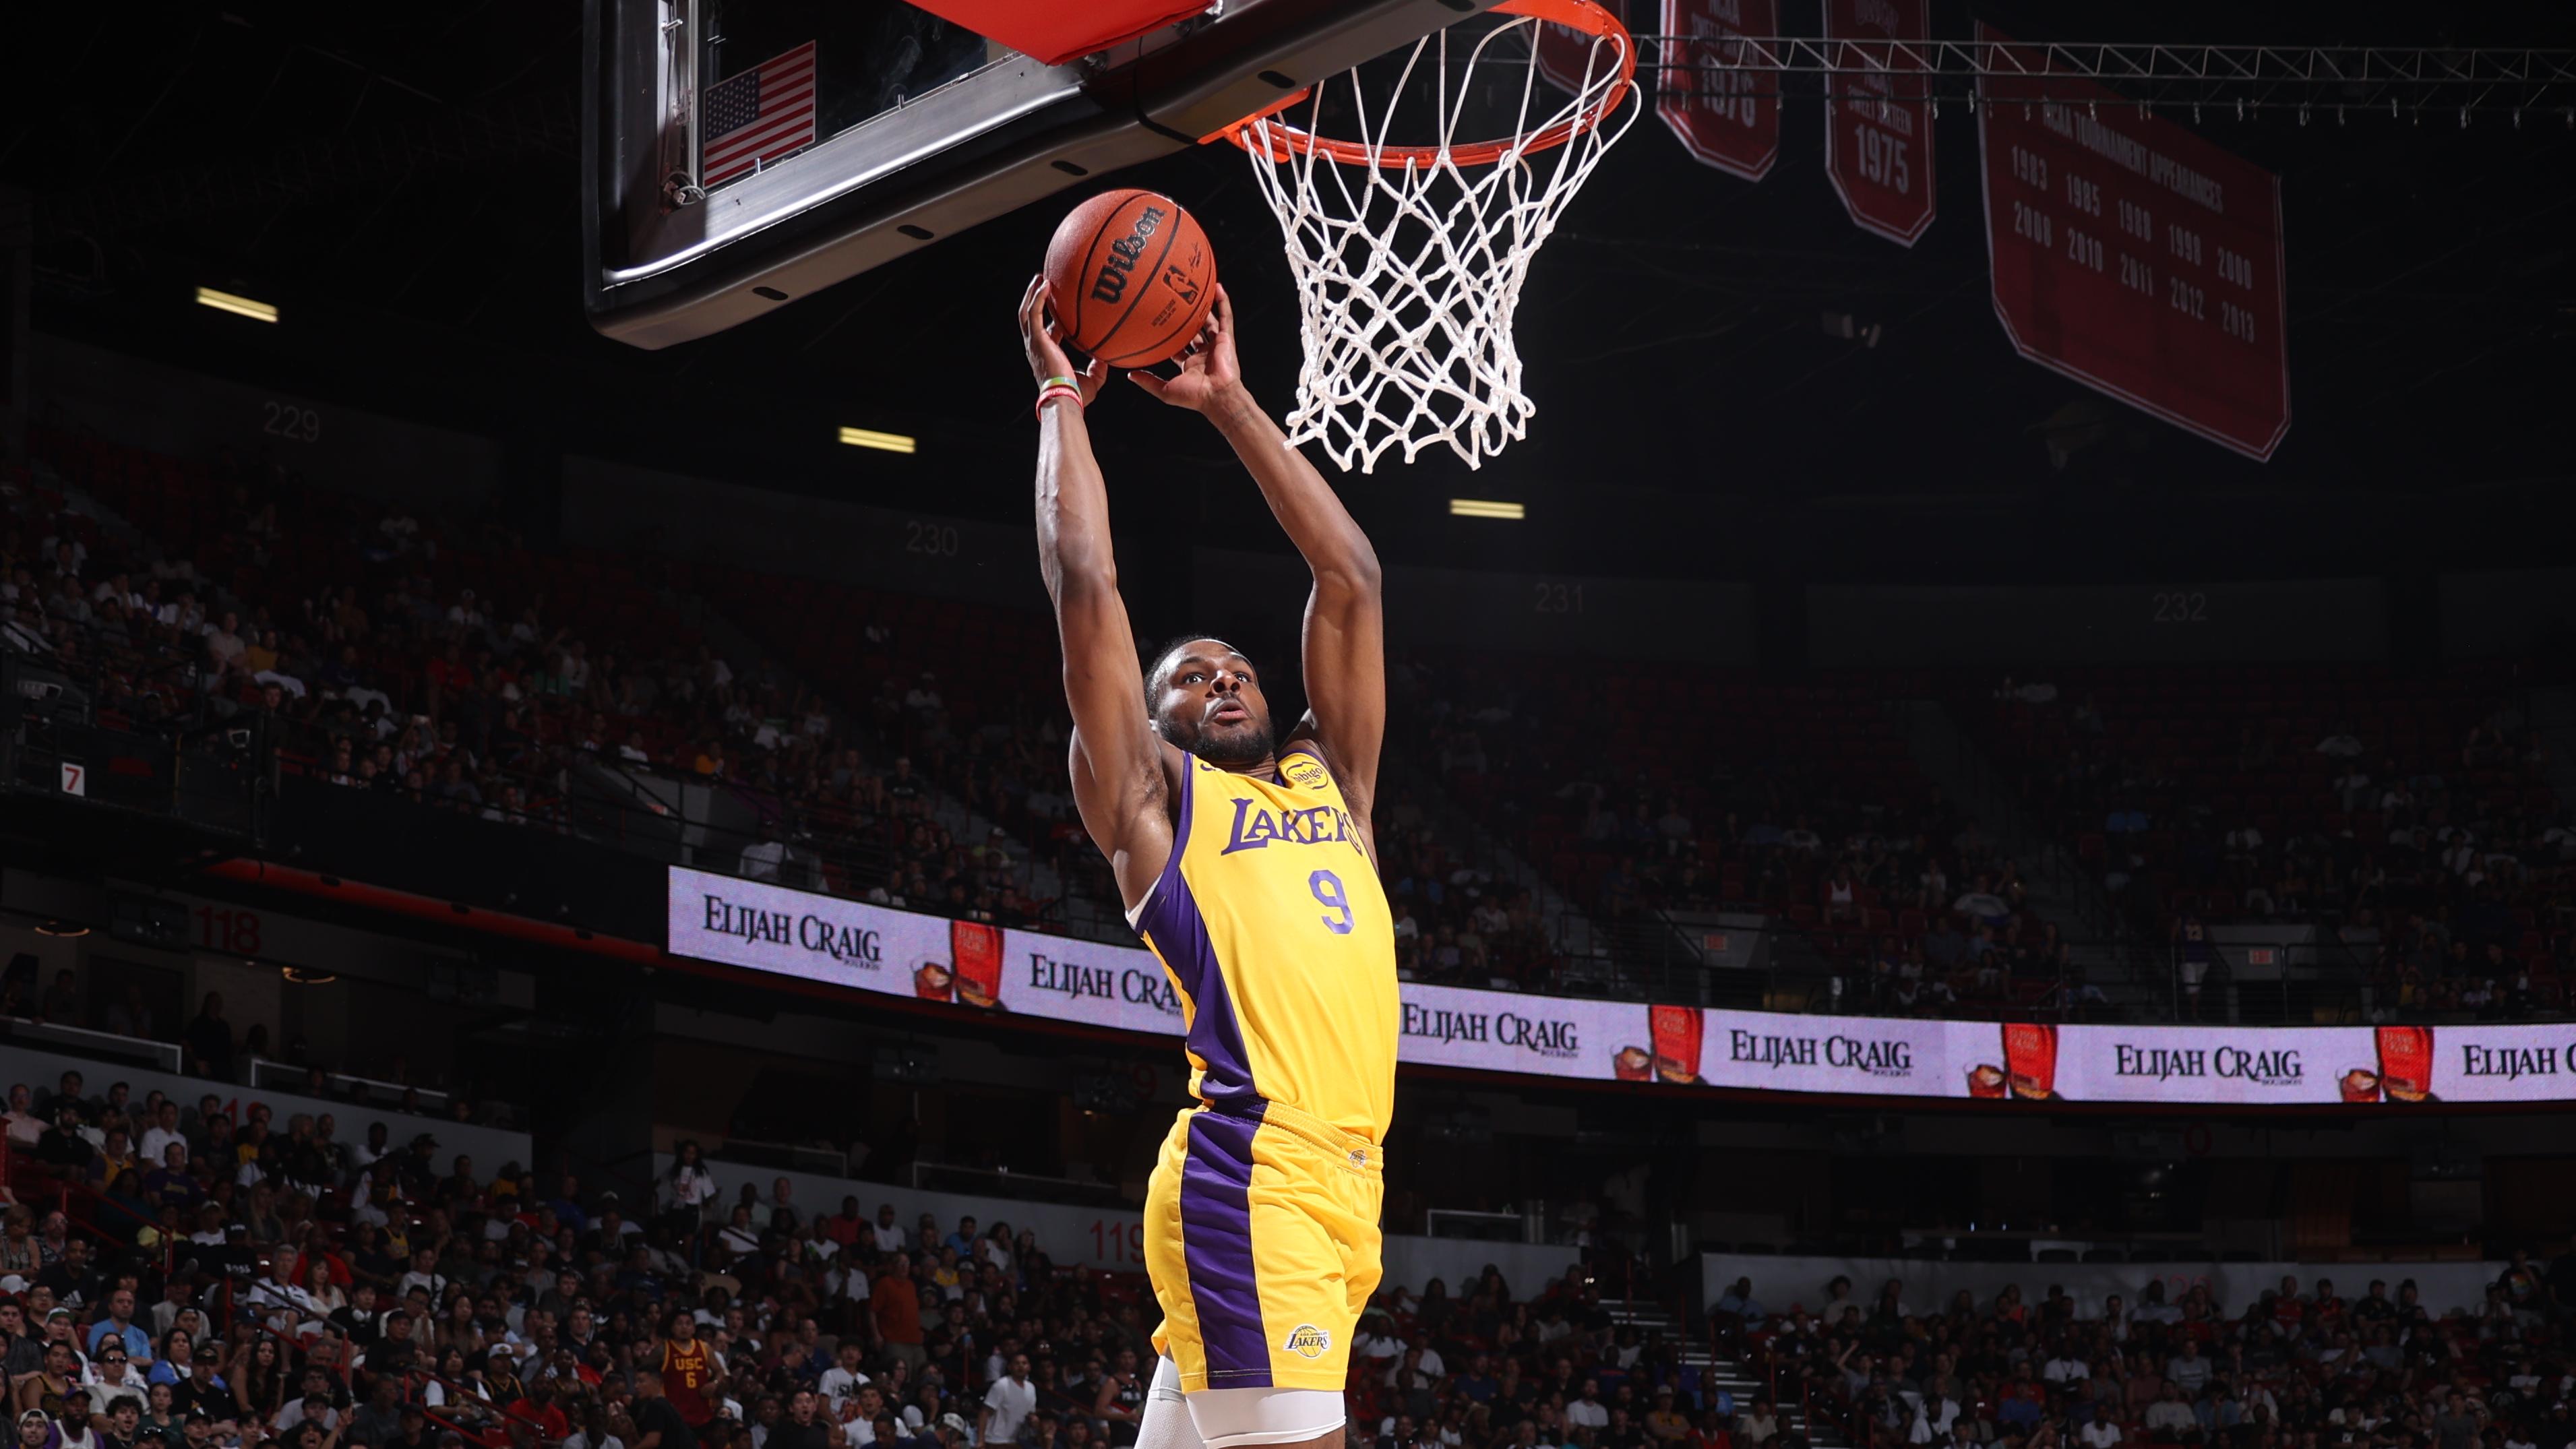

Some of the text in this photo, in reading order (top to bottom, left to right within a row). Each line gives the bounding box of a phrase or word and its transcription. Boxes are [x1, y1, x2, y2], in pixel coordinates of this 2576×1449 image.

[1856, 123, 1909, 195] 1975
[2075, 111, 2148, 177] TOURNAMENT
[2149, 151, 2224, 215] APPEARANCES
[2011, 145, 2252, 290] 1983 1985 1988 1998 2000
[1091, 206, 1167, 304] Wilson
[2013, 200, 2255, 344] 2008 2010 2011 2012 2013
[264, 401, 320, 443] 229
[905, 520, 958, 557] 230
[1533, 582, 1583, 613] 231
[2152, 592, 2207, 622] 232
[65, 766, 81, 791] 7
[1308, 869, 1355, 935] 9
[193, 905, 262, 955] 118
[703, 894, 882, 963] ELIJAH CRAIG
[1029, 953, 1183, 1011] ELIJAH CRA
[1401, 1002, 1579, 1052] ELIJAH CRAIG
[1729, 1029, 1914, 1072] ELIJAH CRAIG
[2115, 1044, 2304, 1082] ELIJAH CRAIG
[2463, 1044, 2558, 1081] ELIJAH
[1283, 1333, 1328, 1349] LAKERS
[675, 1356, 704, 1371] USC
[685, 1371, 698, 1389] 6
